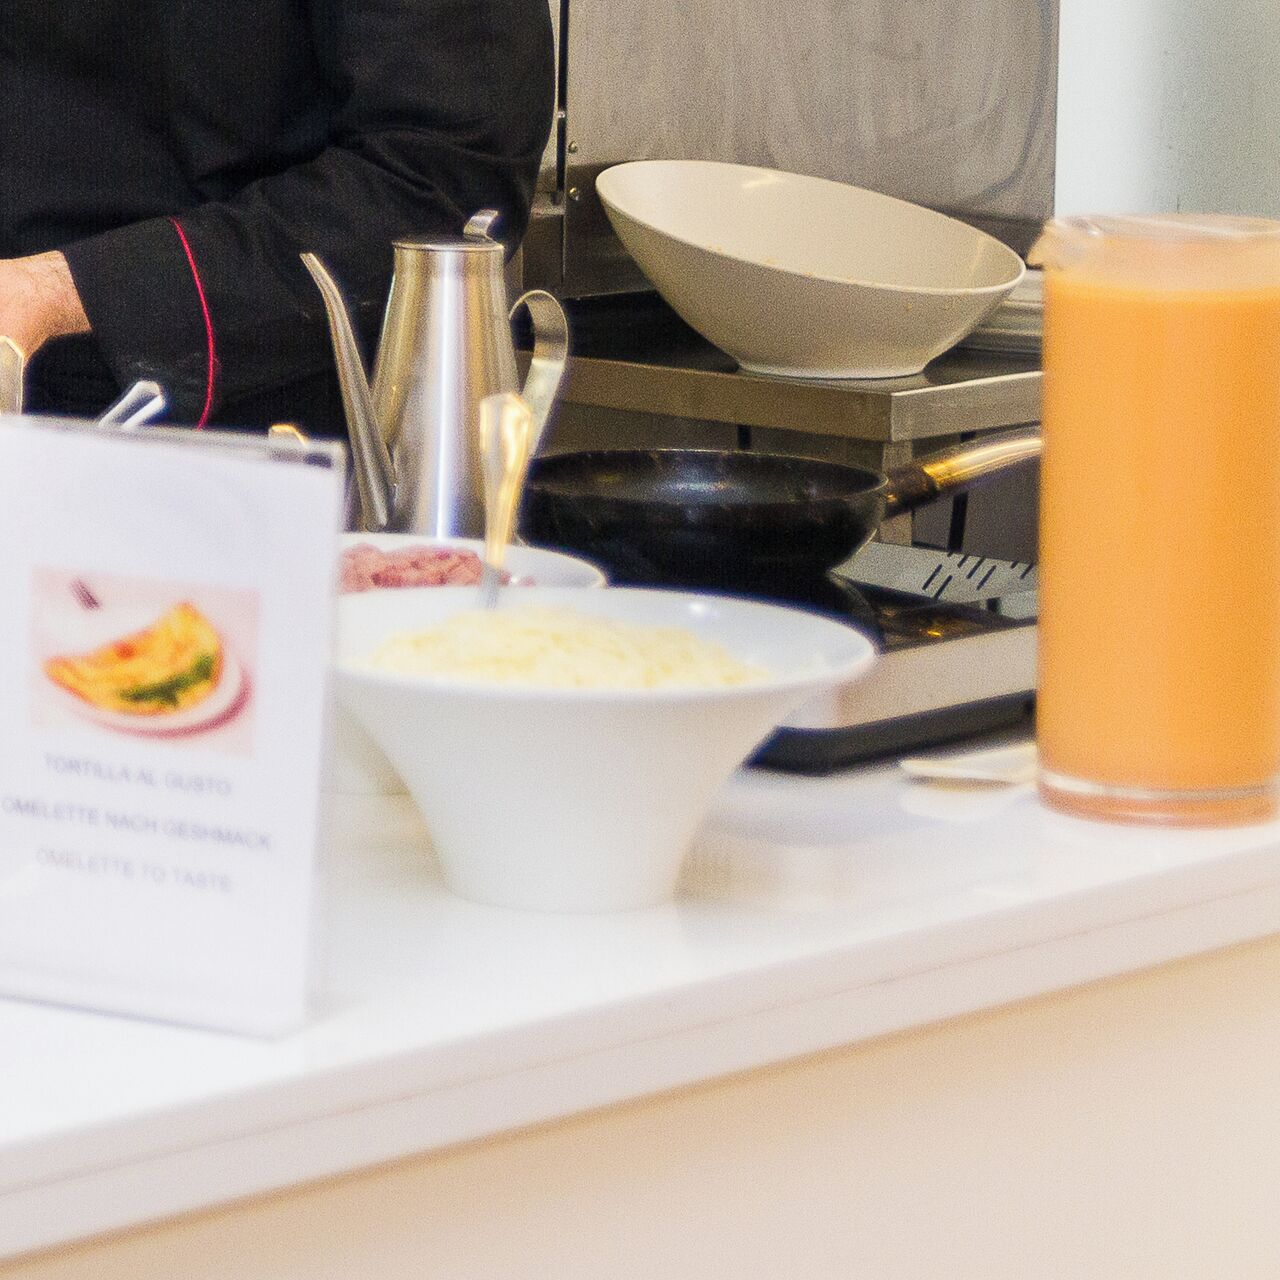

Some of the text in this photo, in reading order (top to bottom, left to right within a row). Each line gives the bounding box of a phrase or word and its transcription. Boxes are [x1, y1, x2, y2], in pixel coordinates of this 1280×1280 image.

[42, 751, 232, 798] TORTILLA AL GUSTO
[1, 794, 100, 826] OMELETTE
[104, 810, 158, 833] NACH
[35, 846, 135, 879] OMELETTE
[173, 866, 233, 894] TASTE
